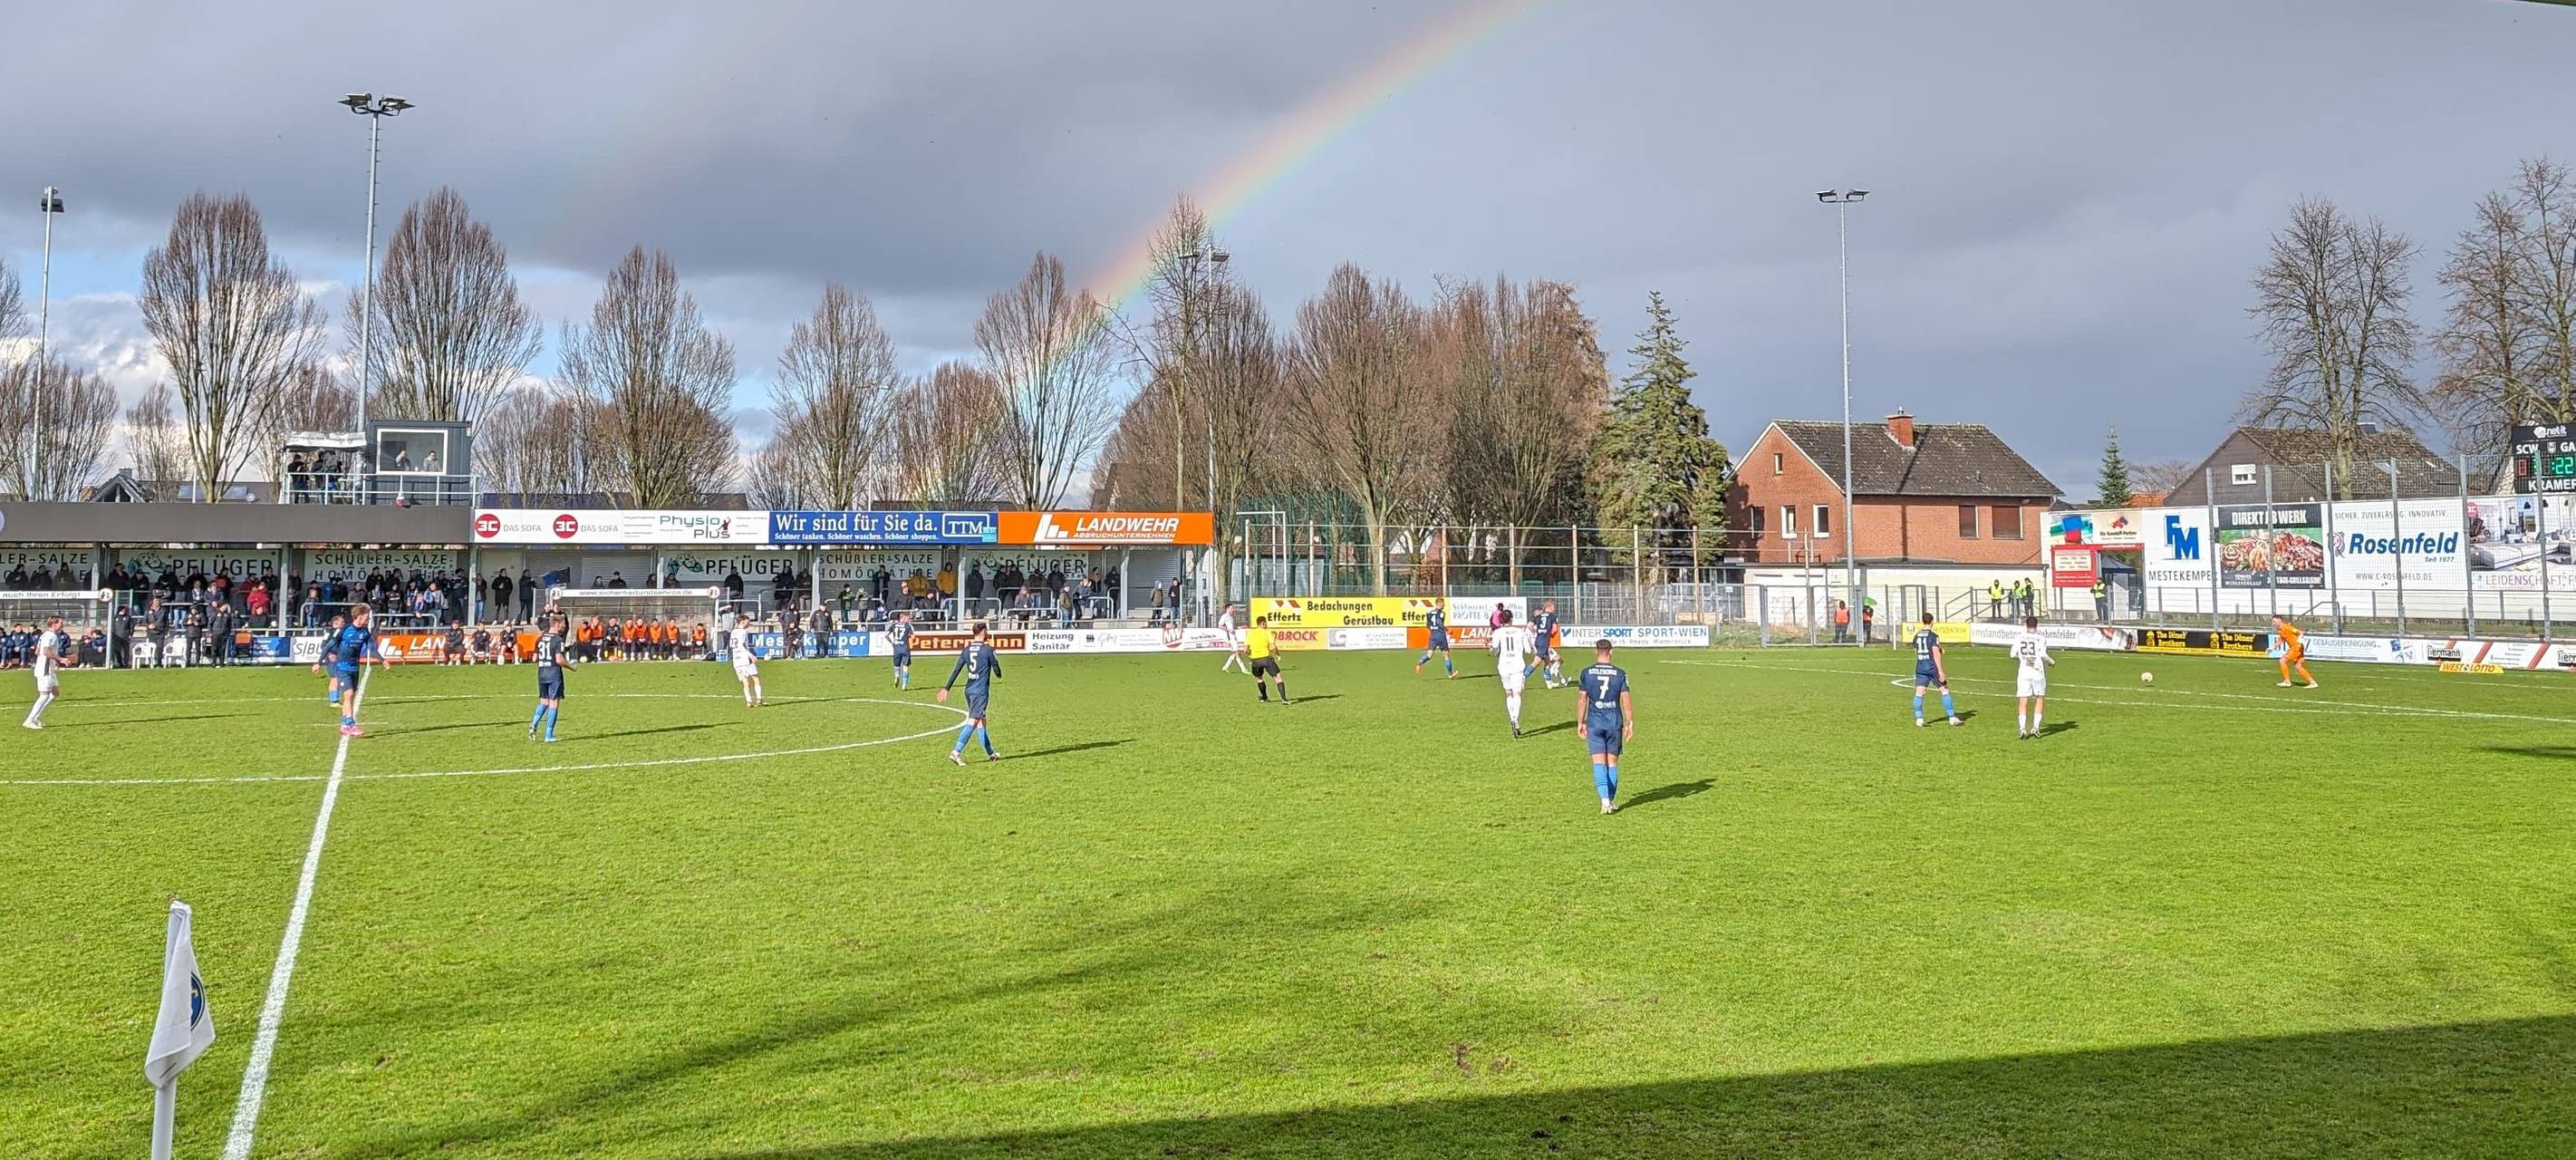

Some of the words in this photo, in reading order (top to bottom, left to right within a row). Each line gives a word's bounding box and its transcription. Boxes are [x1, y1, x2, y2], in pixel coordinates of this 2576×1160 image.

[776, 514, 807, 531] Wir
[813, 513, 848, 531] sind
[853, 513, 879, 531] für
[883, 514, 909, 531] Sie
[913, 514, 938, 531] da.
[1076, 517, 1180, 532] LANDWEHR
[2232, 511, 2264, 526] DIREKT
[2278, 509, 2307, 524] WERK
[581, 525, 596, 533] DAS
[598, 525, 619, 533] SOFA
[948, 521, 983, 535] TTM
[774, 532, 800, 540] Schöner
[826, 532, 854, 540] Schöner
[883, 532, 910, 540] Schöner
[2349, 531, 2459, 555] Rosenfeld
[173, 555, 273, 575] PFLÜGER
[706, 555, 793, 575] PFLÜGER
[1307, 601, 1373, 613] Bedachungen
[1268, 613, 1301, 622] Effertz
[1344, 614, 1394, 626] Gerüstbau
[1539, 614, 1547, 628] 3
[894, 627, 906, 640] 17
[1032, 633, 1075, 641] Heizung
[538, 641, 552, 661] 31
[1032, 643, 1071, 651] Sanitär
[1506, 636, 1514, 652] 11
[1916, 636, 1930, 653] 11
[2020, 641, 2036, 656] 23
[969, 652, 979, 672] 5
[2470, 664, 2495, 672] LOTTO
[1597, 676, 1610, 700] 7
